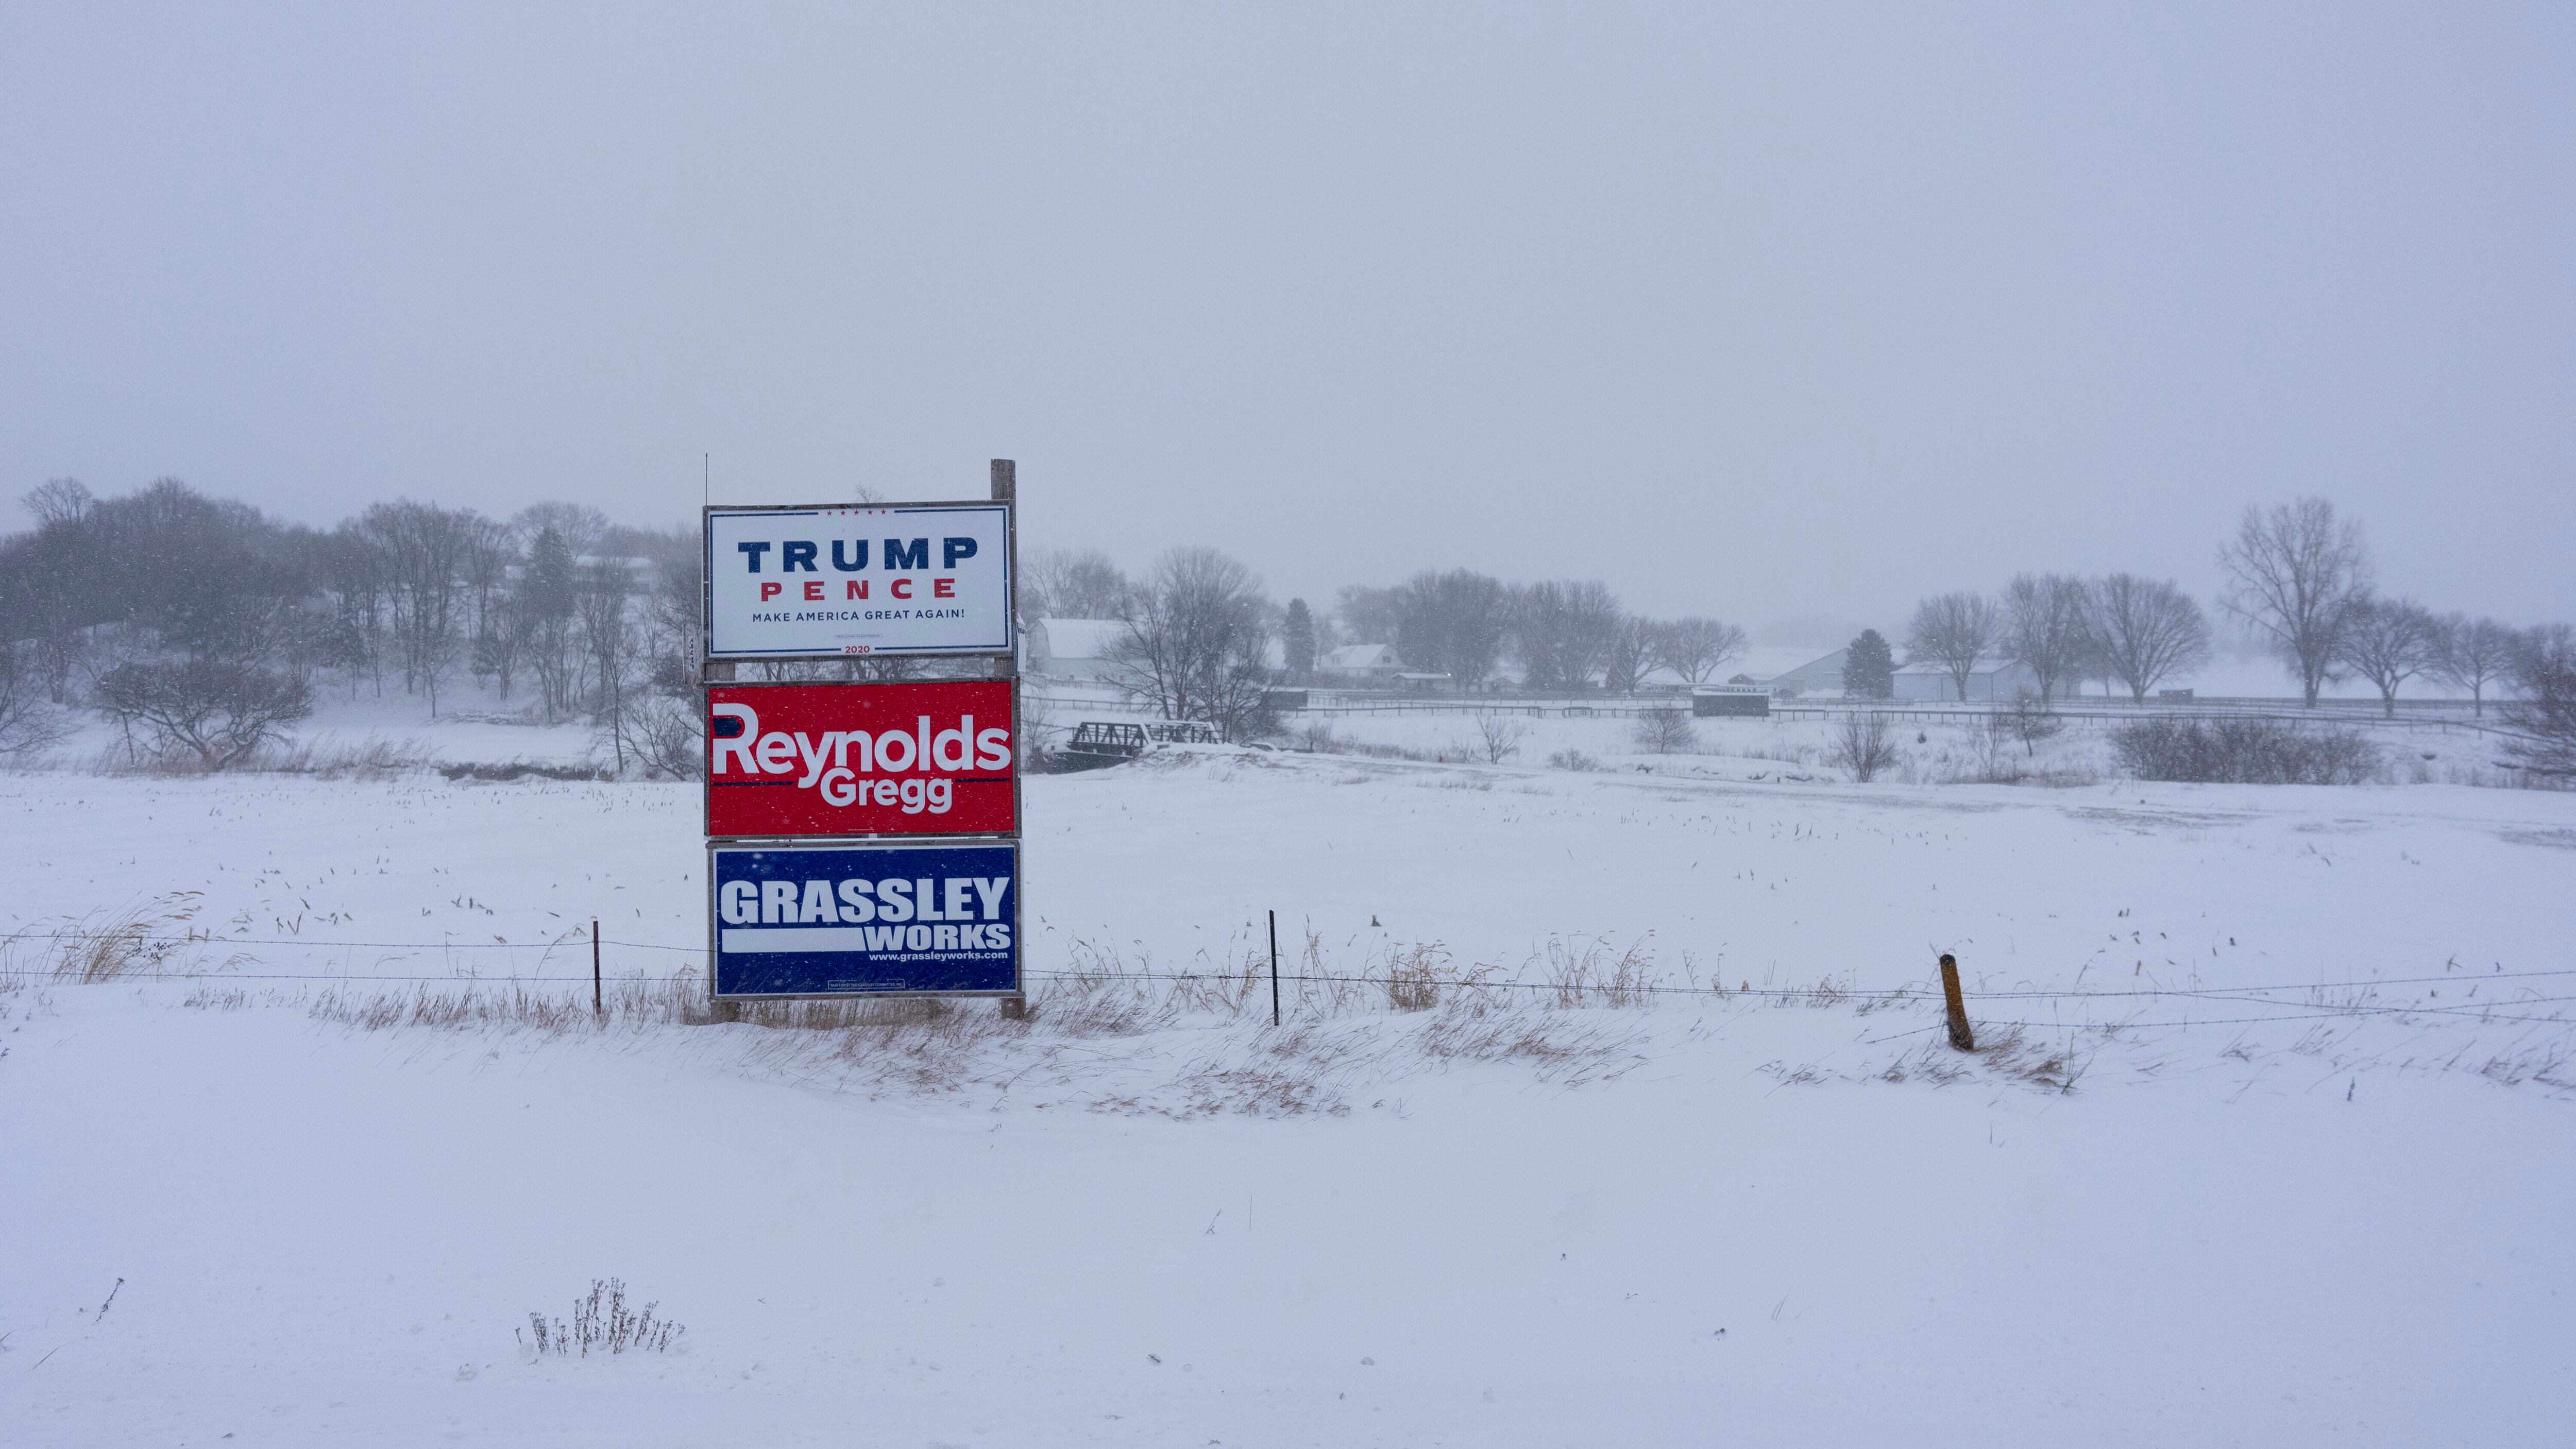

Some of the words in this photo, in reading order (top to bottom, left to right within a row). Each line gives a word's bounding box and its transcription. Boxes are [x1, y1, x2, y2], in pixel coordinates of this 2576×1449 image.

[738, 537, 978, 573] TRUMP
[761, 578, 955, 602] PENCE
[752, 612, 790, 622] MAKE
[796, 611, 859, 621] AMERICA
[865, 610, 910, 620] GREAT
[915, 609, 964, 619] AGAIN!
[845, 645, 870, 654] 2020
[713, 704, 1011, 788] Reynolds
[820, 767, 953, 814] Gregg
[721, 877, 1010, 924] GRASSLEY
[864, 924, 1011, 951] WORKS
[869, 951, 1008, 962] www.grassleyworks.com
